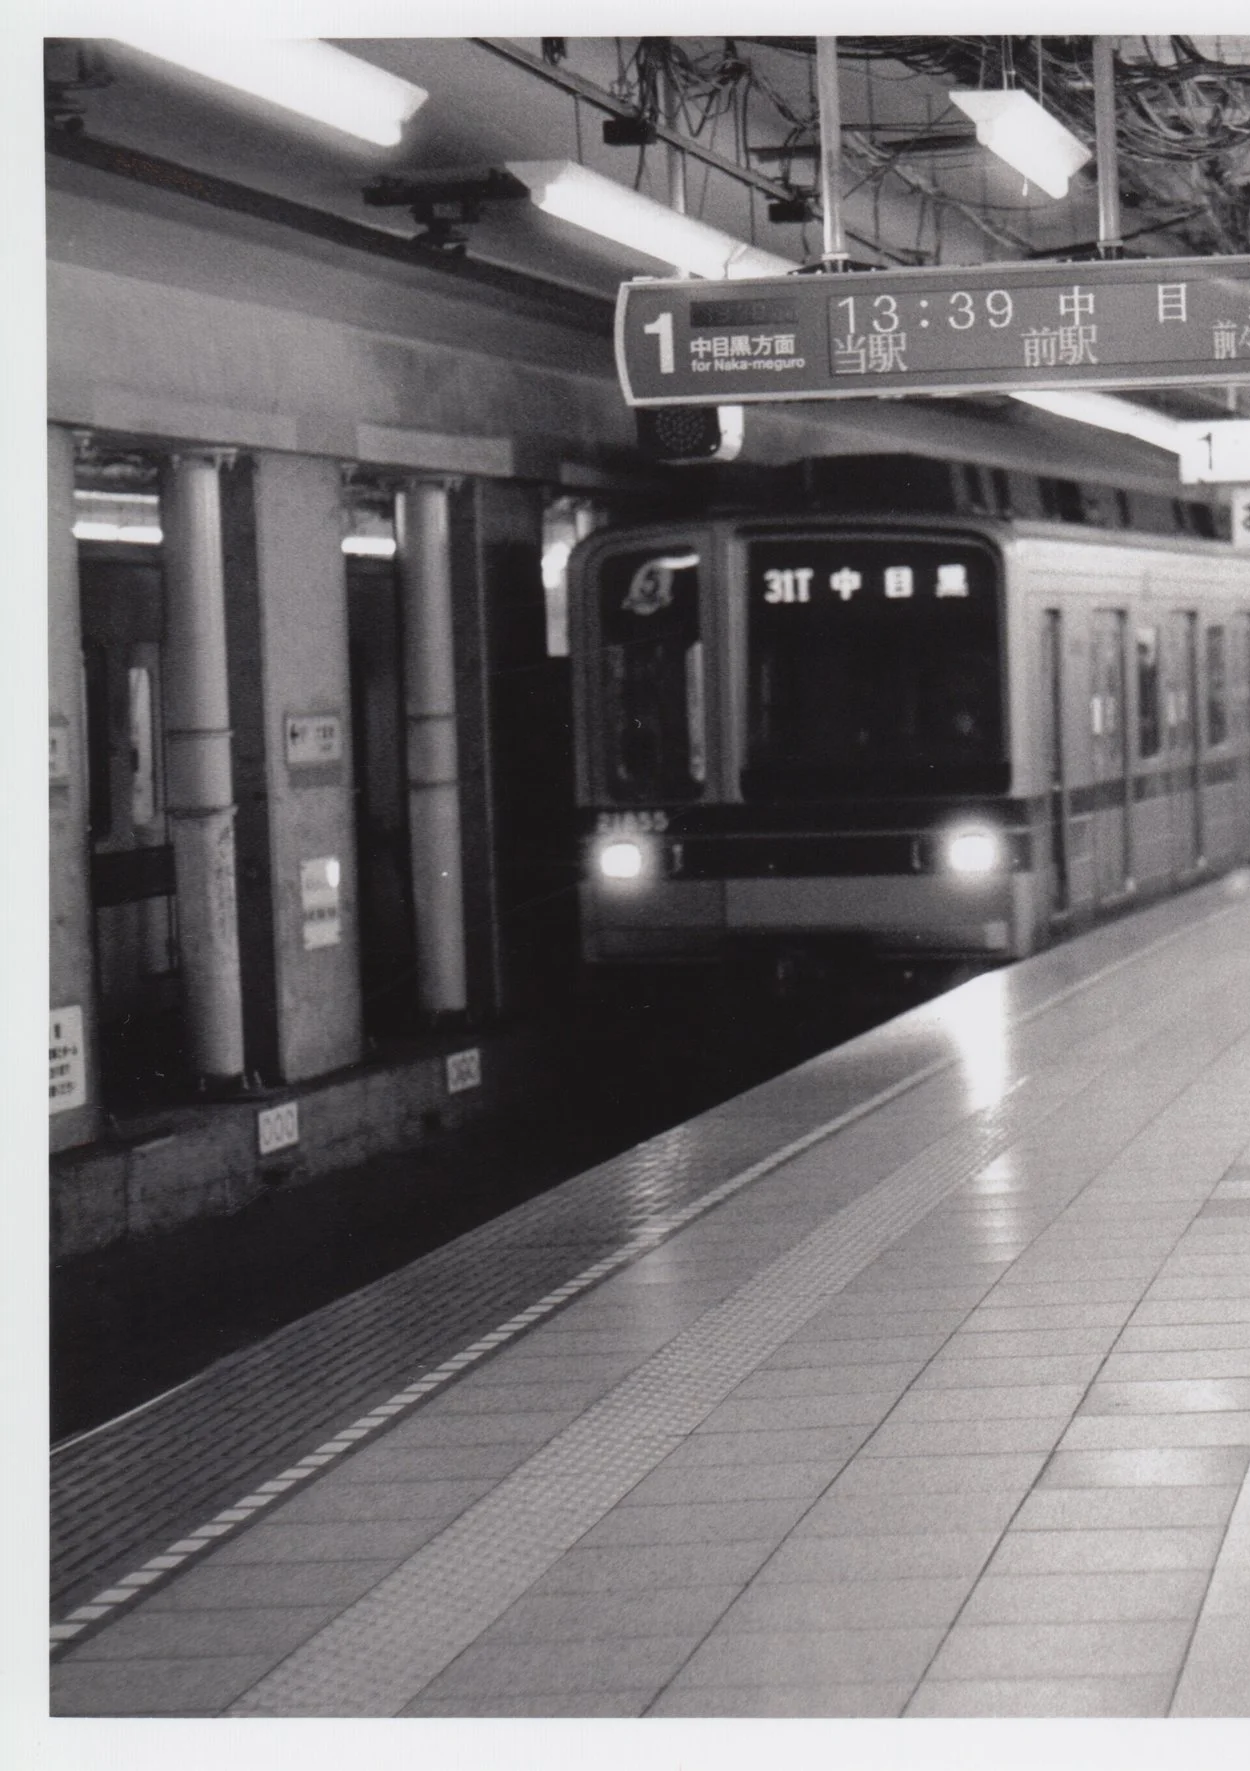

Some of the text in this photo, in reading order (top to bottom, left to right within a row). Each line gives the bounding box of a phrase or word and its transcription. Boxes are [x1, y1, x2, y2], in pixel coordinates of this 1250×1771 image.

[837, 289, 1014, 334] 13:39
[643, 312, 675, 375] 1
[690, 333, 796, 359] 中目黒方面
[833, 331, 909, 375] 当駅
[1020, 324, 1098, 368] 前駅
[691, 357, 806, 372] for Naka-meguro
[763, 566, 814, 604] 31T
